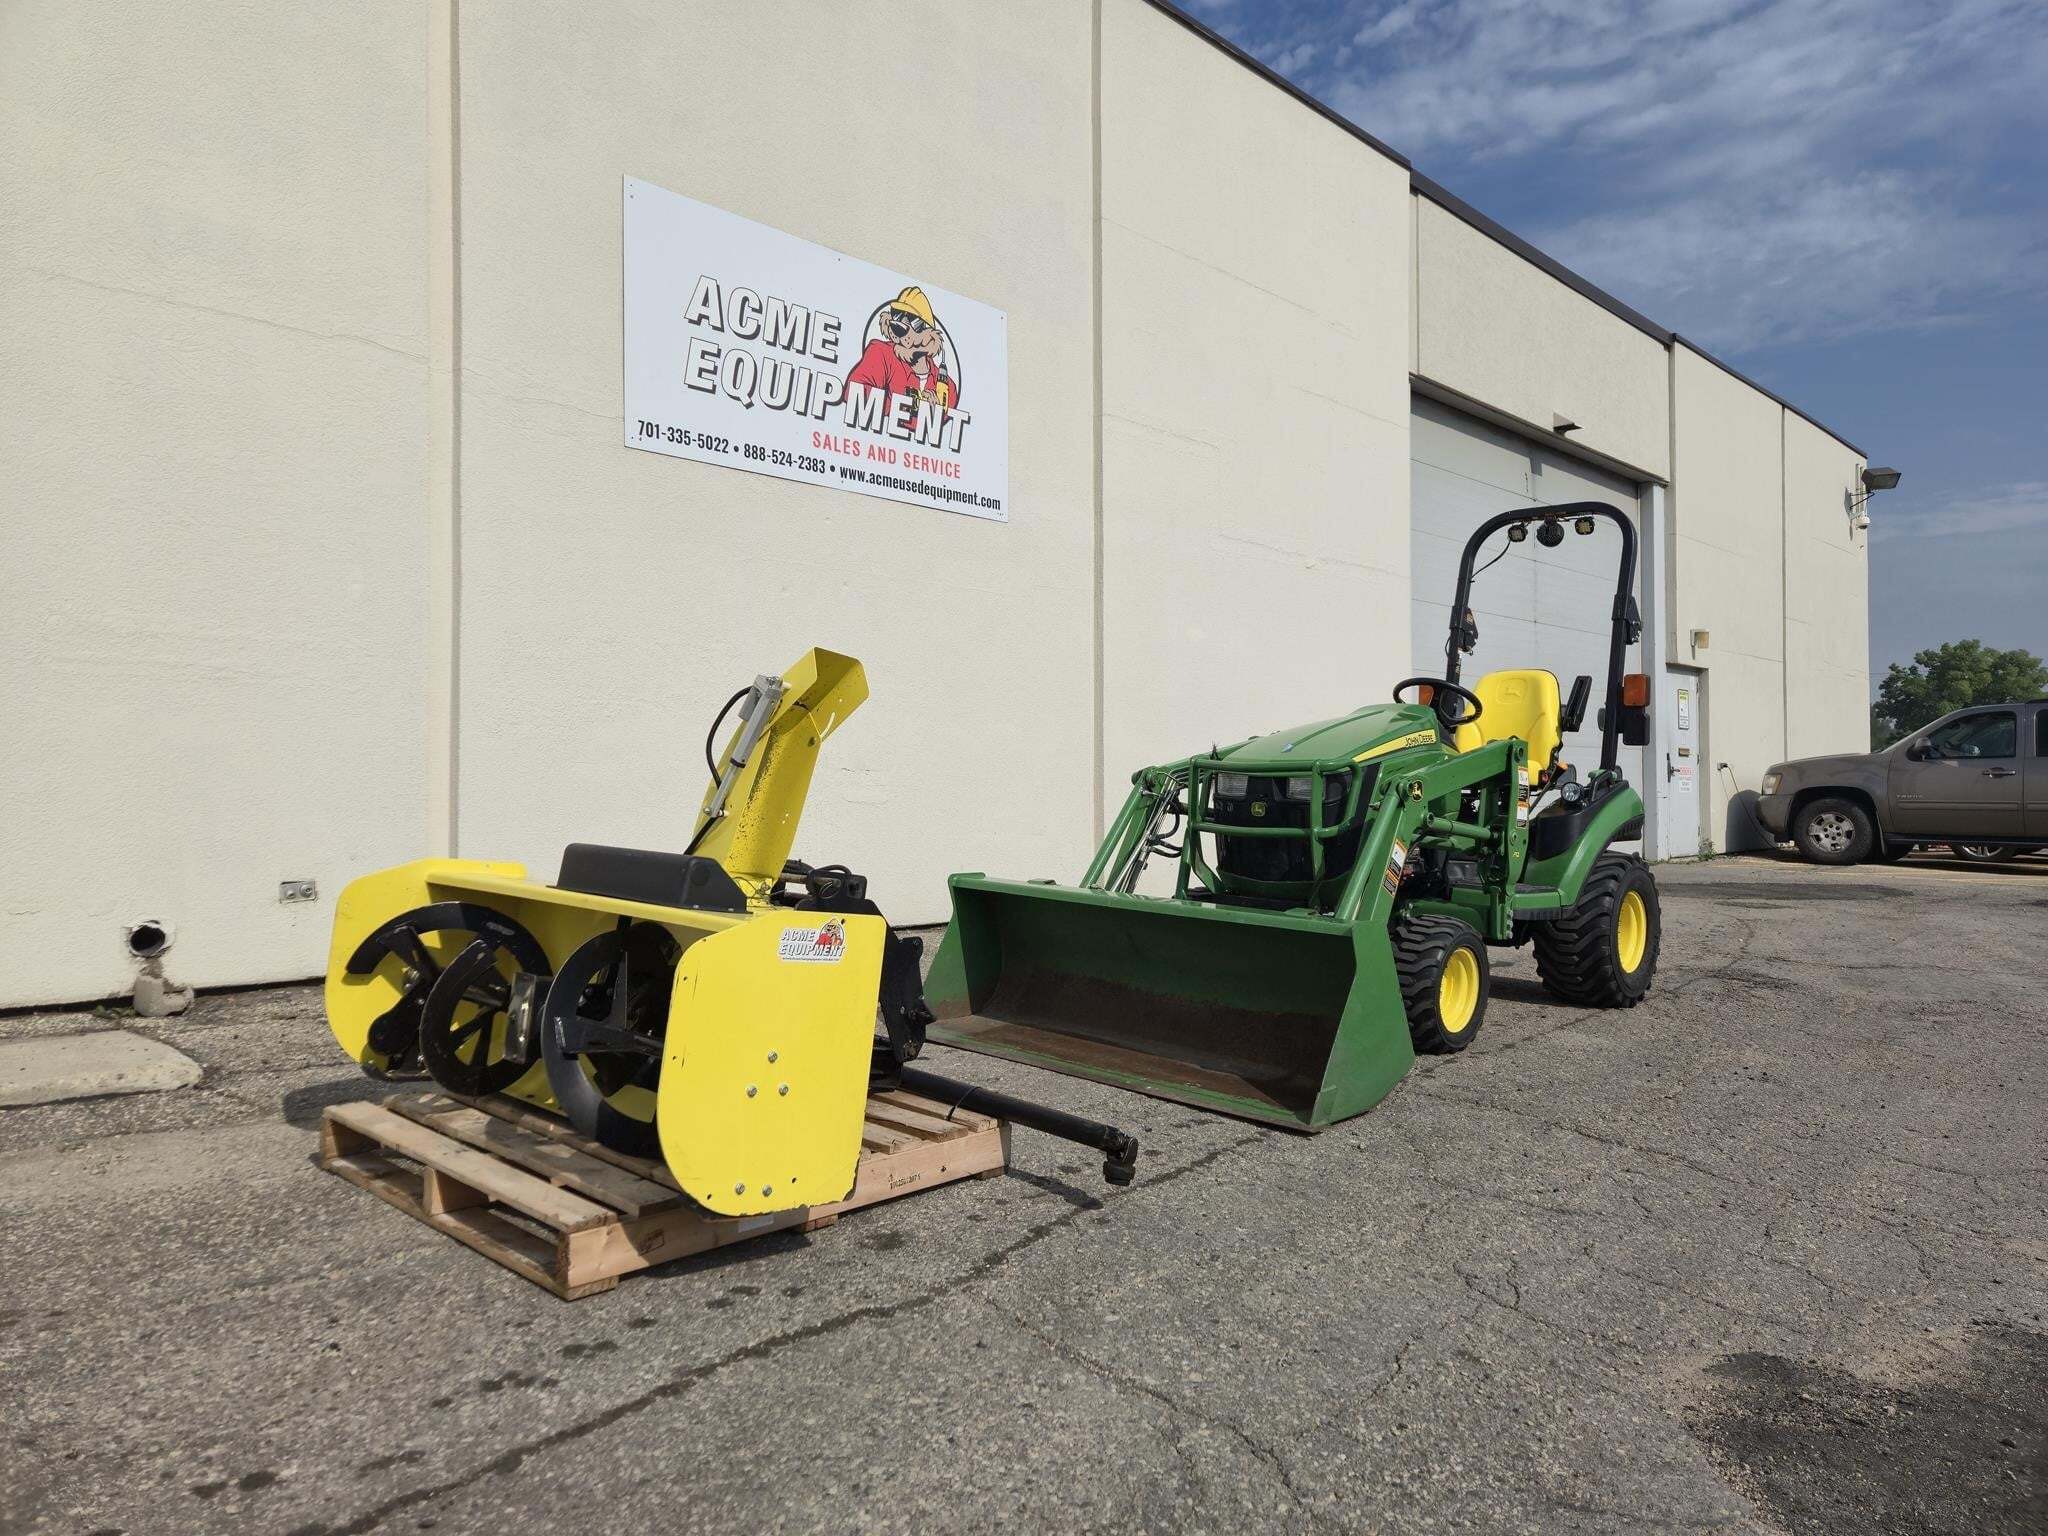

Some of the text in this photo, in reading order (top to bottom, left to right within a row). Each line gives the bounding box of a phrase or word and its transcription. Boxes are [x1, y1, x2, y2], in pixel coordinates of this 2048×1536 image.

[684, 275, 842, 364] ACME
[683, 337, 971, 453] EQUIPMENT
[638, 420, 1001, 511] 701-335-5022 888-524-2383 www.acmeusedequipment.com
[812, 431, 961, 479] SALES AND SERVICE
[1405, 734, 1434, 746] JOHN DEERE
[779, 943, 845, 957] EQUIPMENT
[781, 929, 816, 942] ACME
